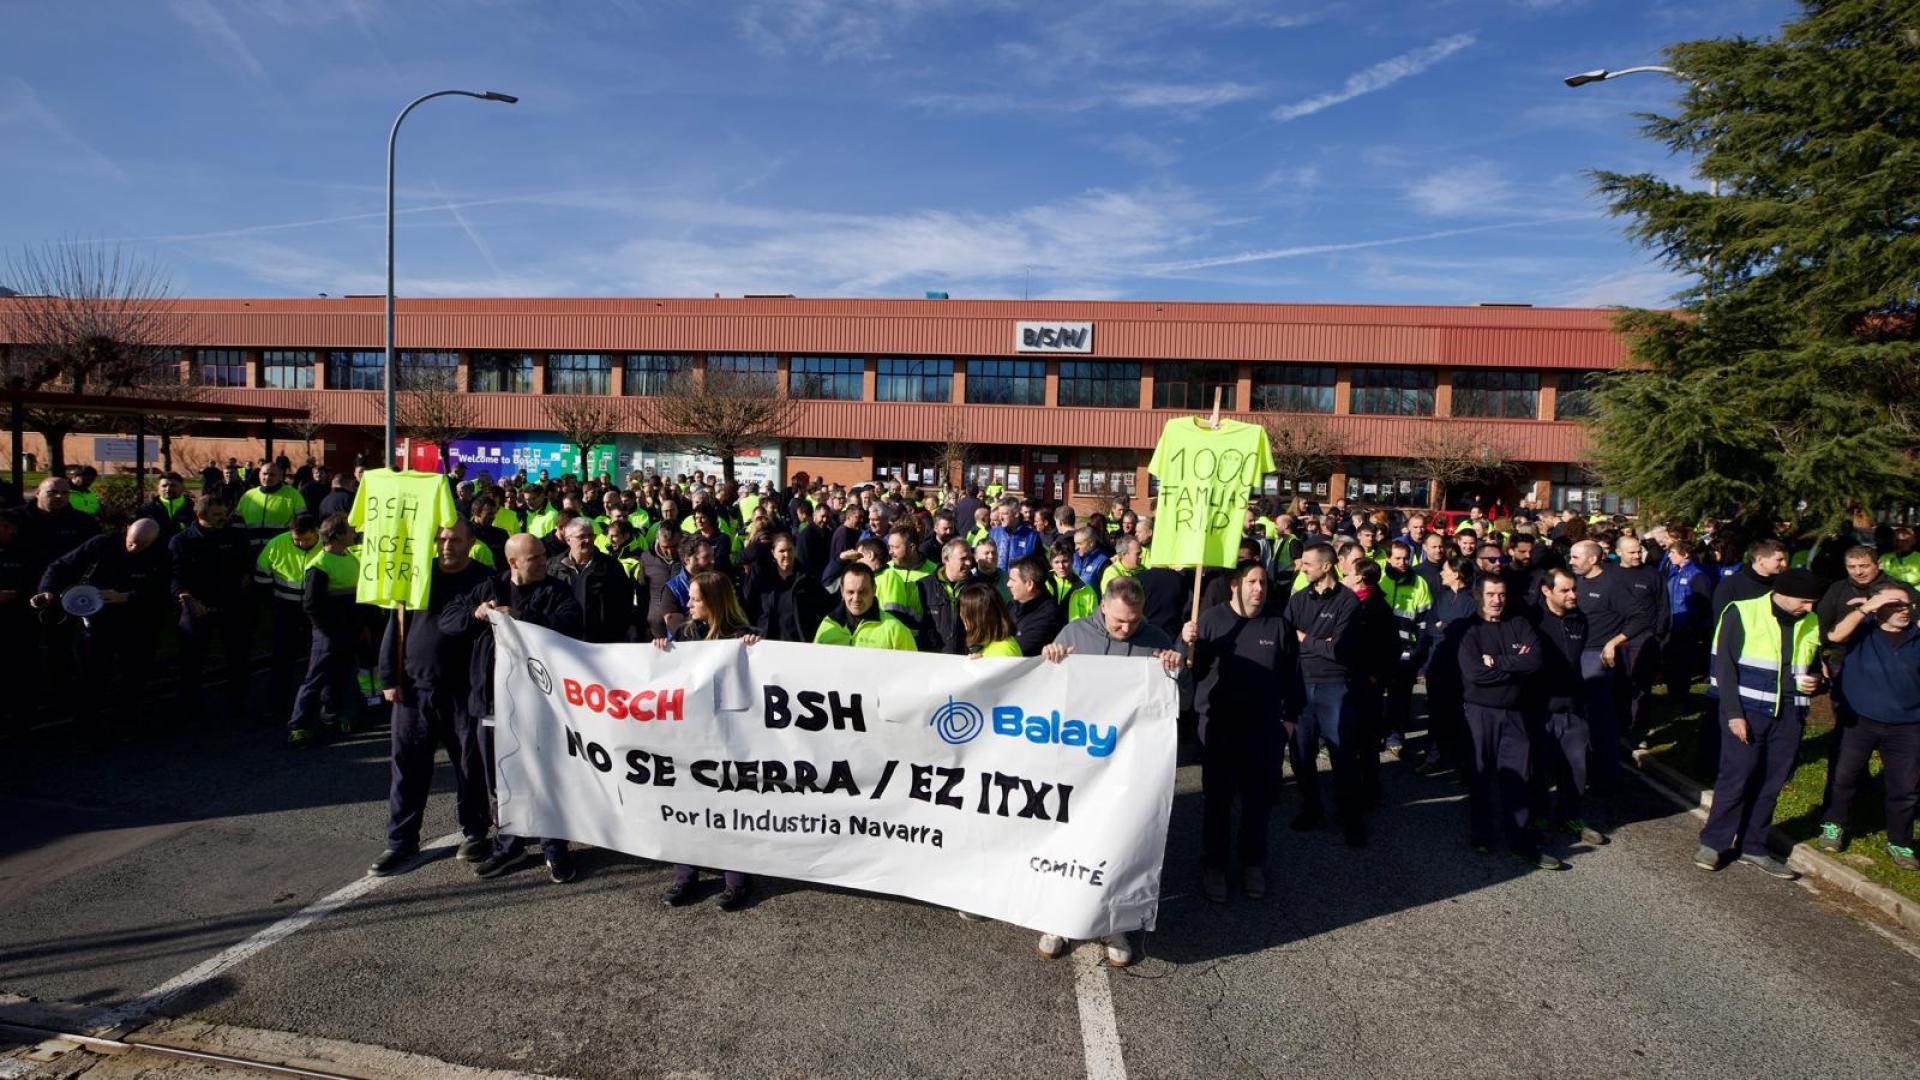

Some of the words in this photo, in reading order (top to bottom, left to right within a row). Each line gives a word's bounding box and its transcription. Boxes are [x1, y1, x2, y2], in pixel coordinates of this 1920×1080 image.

[459, 454, 499, 463] Welcome
[501, 455, 511, 464] to
[1171, 448, 1258, 487] 1000
[367, 496, 418, 521] BSH
[563, 678, 684, 722] BOSCH
[764, 685, 867, 733] BSH
[992, 705, 1118, 758] Balay
[565, 724, 613, 773] NO
[626, 750, 677, 787] SE
[690, 759, 860, 798] CIERRA
[909, 763, 965, 810] EZ
[977, 771, 1074, 824] ITXI
[660, 804, 700, 826] Por
[705, 808, 727, 829] la
[733, 808, 841, 835] Industria
[849, 815, 944, 848] Navarra
